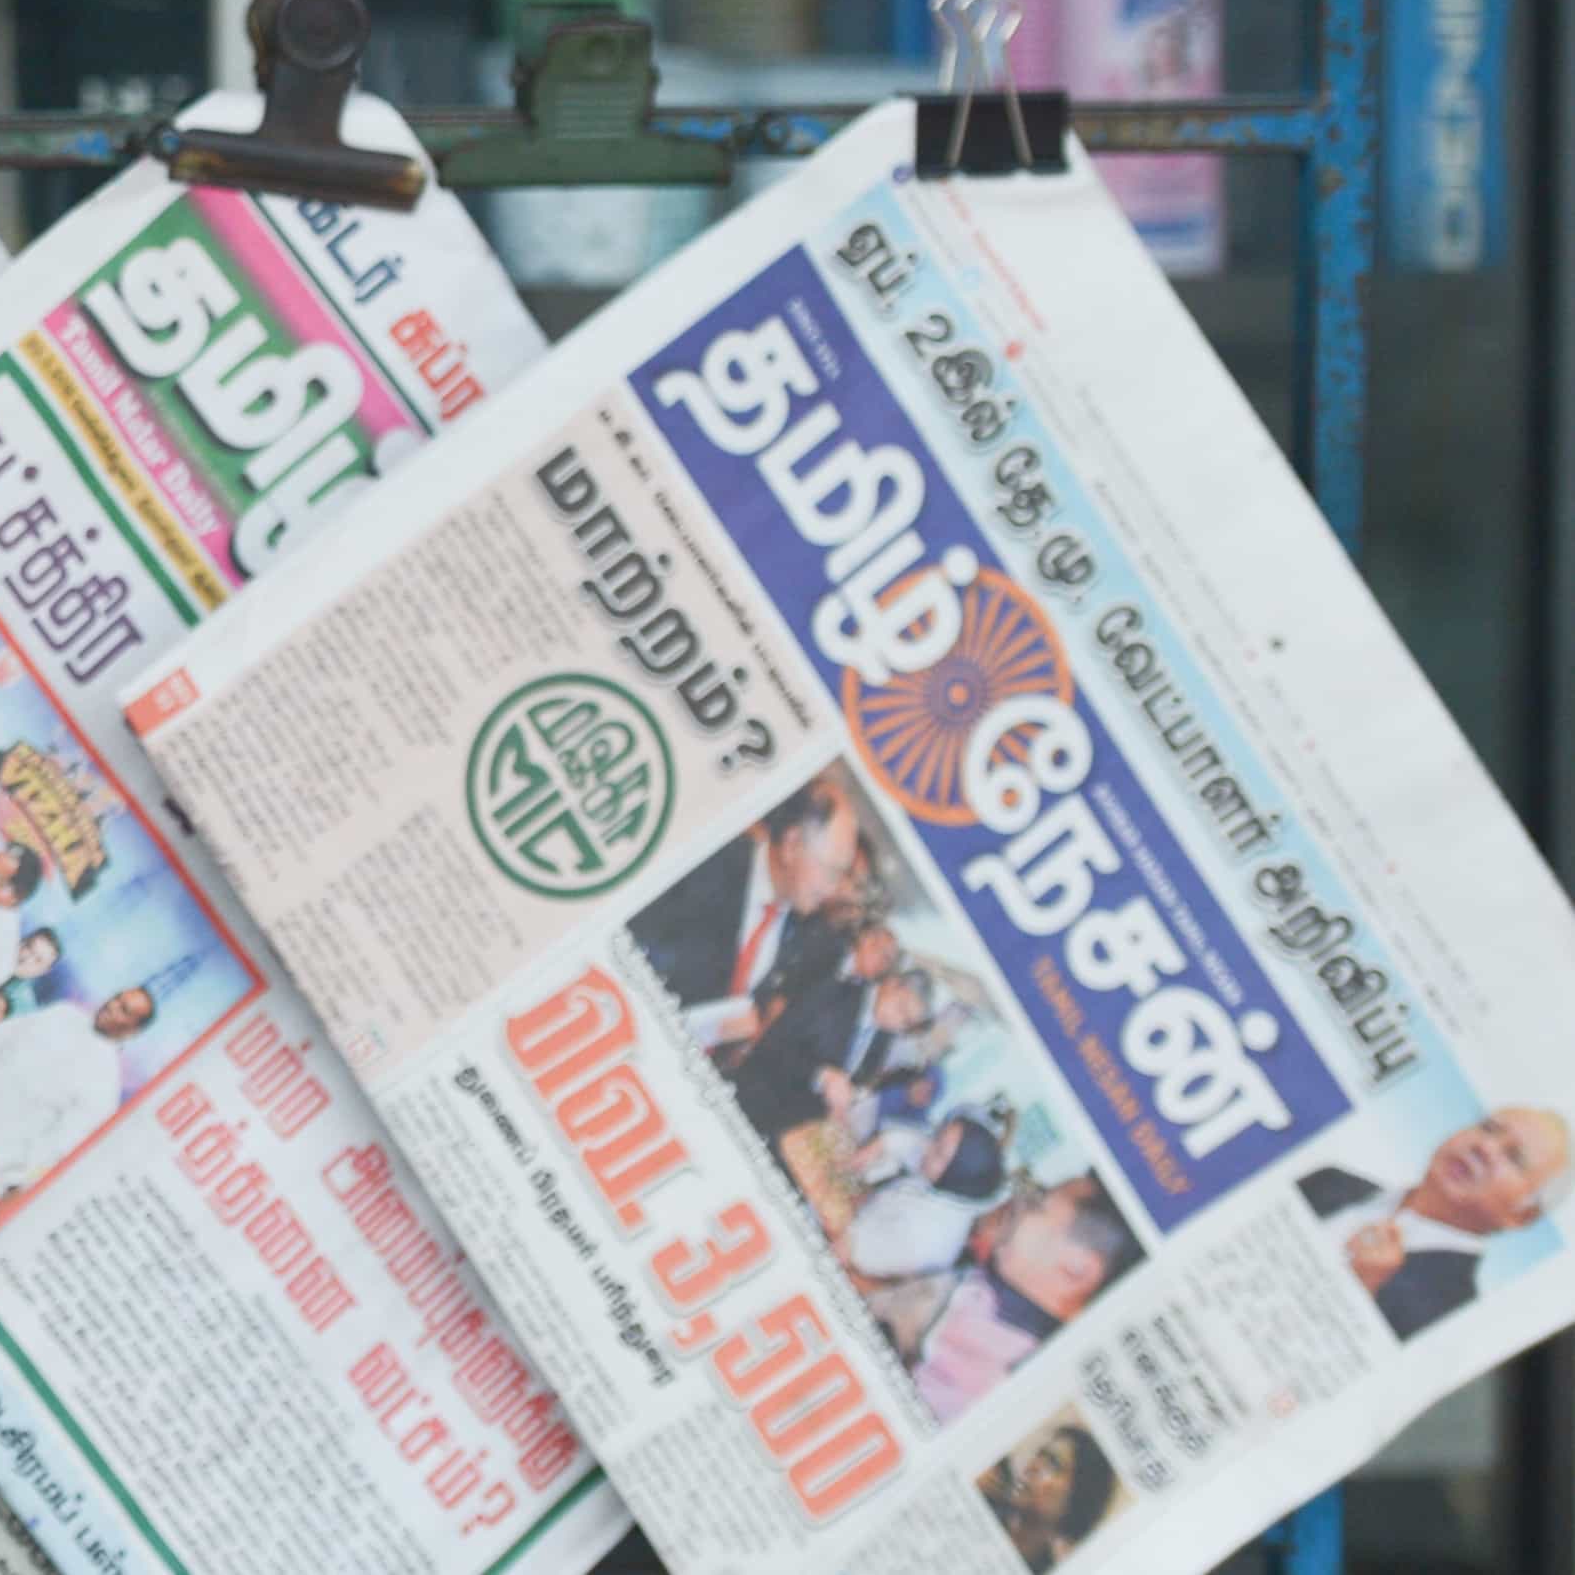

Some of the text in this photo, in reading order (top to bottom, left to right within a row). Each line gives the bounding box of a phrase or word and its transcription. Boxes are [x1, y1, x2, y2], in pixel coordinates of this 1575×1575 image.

[60, 309, 234, 536] Tamil Malar Daily
[534, 445, 776, 763] மாற்றம்?
[487, 746, 599, 882] MIC
[662, 322, 984, 678] தமிழ்
[964, 703, 1283, 1155] நேசன்
[1094, 605, 1272, 854] வேட்பாளர்
[221, 1003, 333, 1142] மற்ற
[505, 965, 688, 1228] வெ.
[650, 1201, 902, 1518] 3,500
